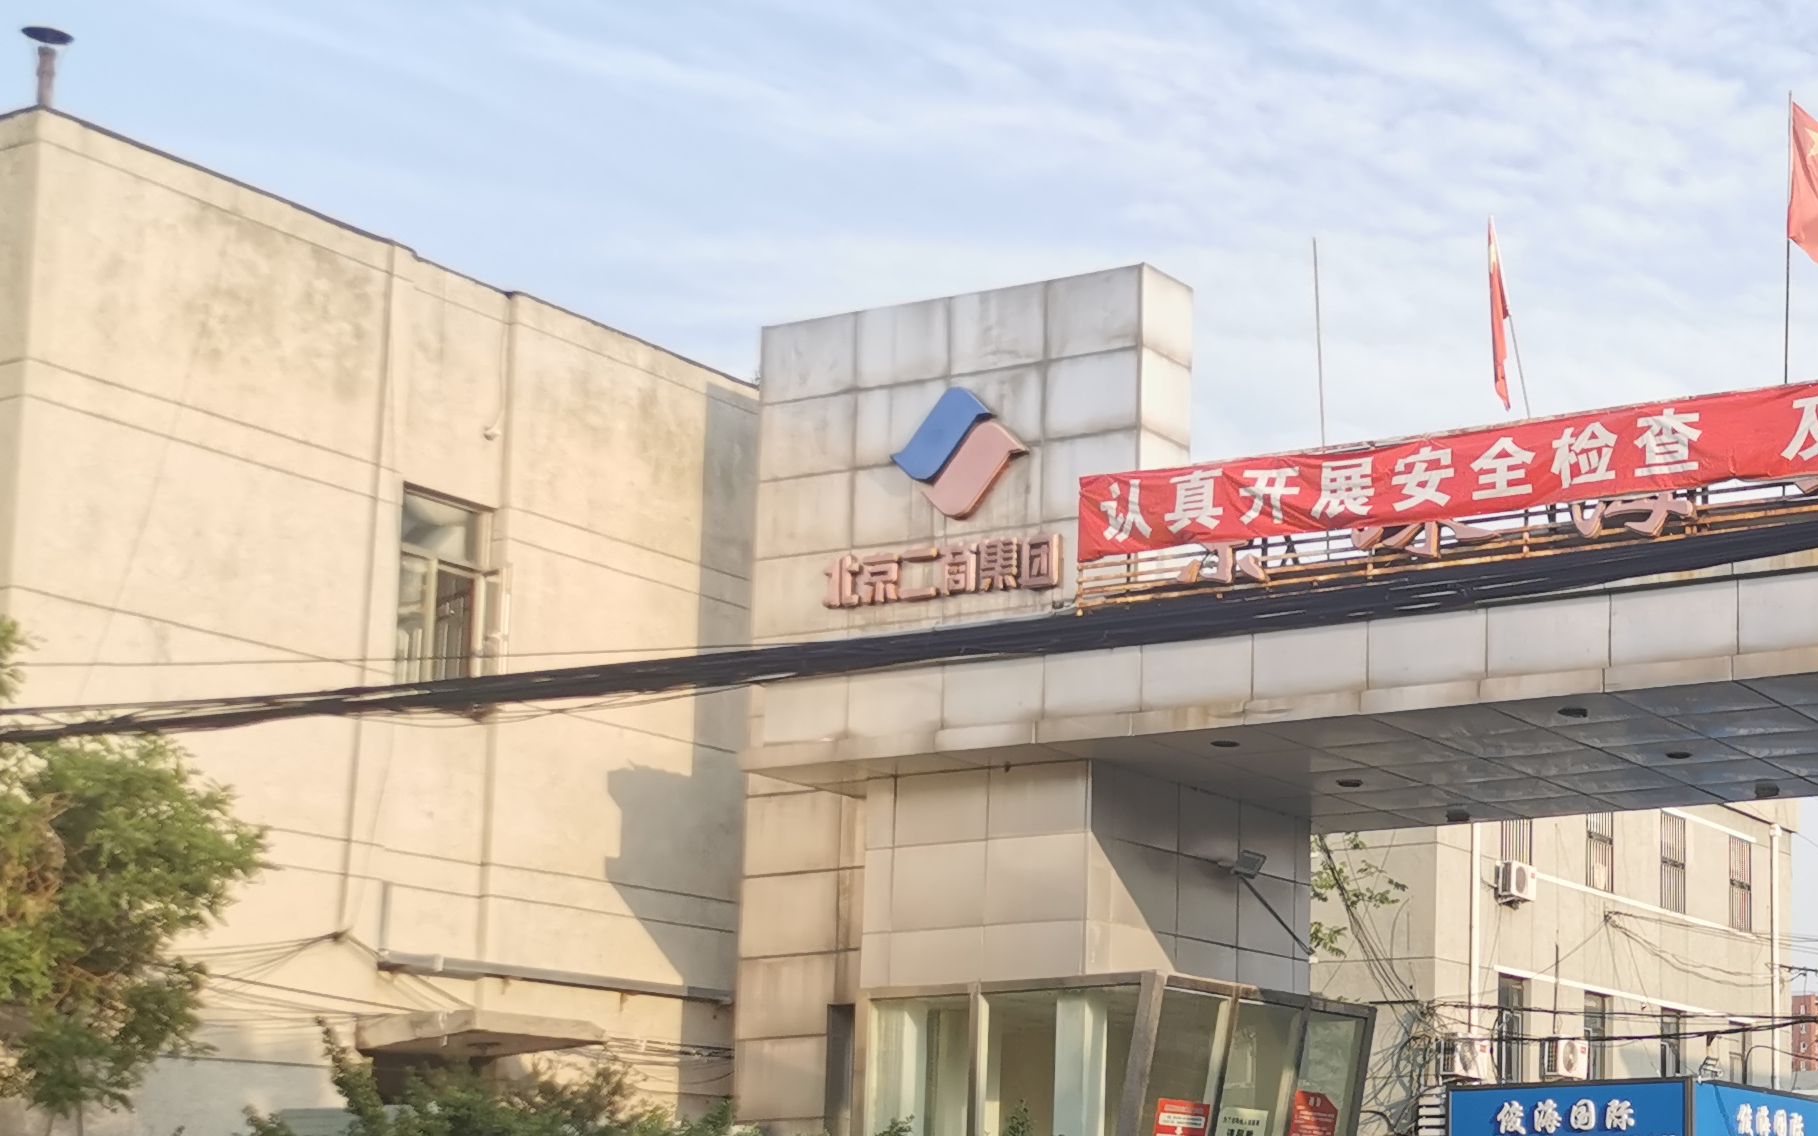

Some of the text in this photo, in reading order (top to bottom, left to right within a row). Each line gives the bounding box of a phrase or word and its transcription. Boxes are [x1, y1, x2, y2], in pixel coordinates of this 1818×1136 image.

[1101, 406, 1702, 543] 认真开展安全检查
[823, 533, 1063, 609] 北京二商集团
